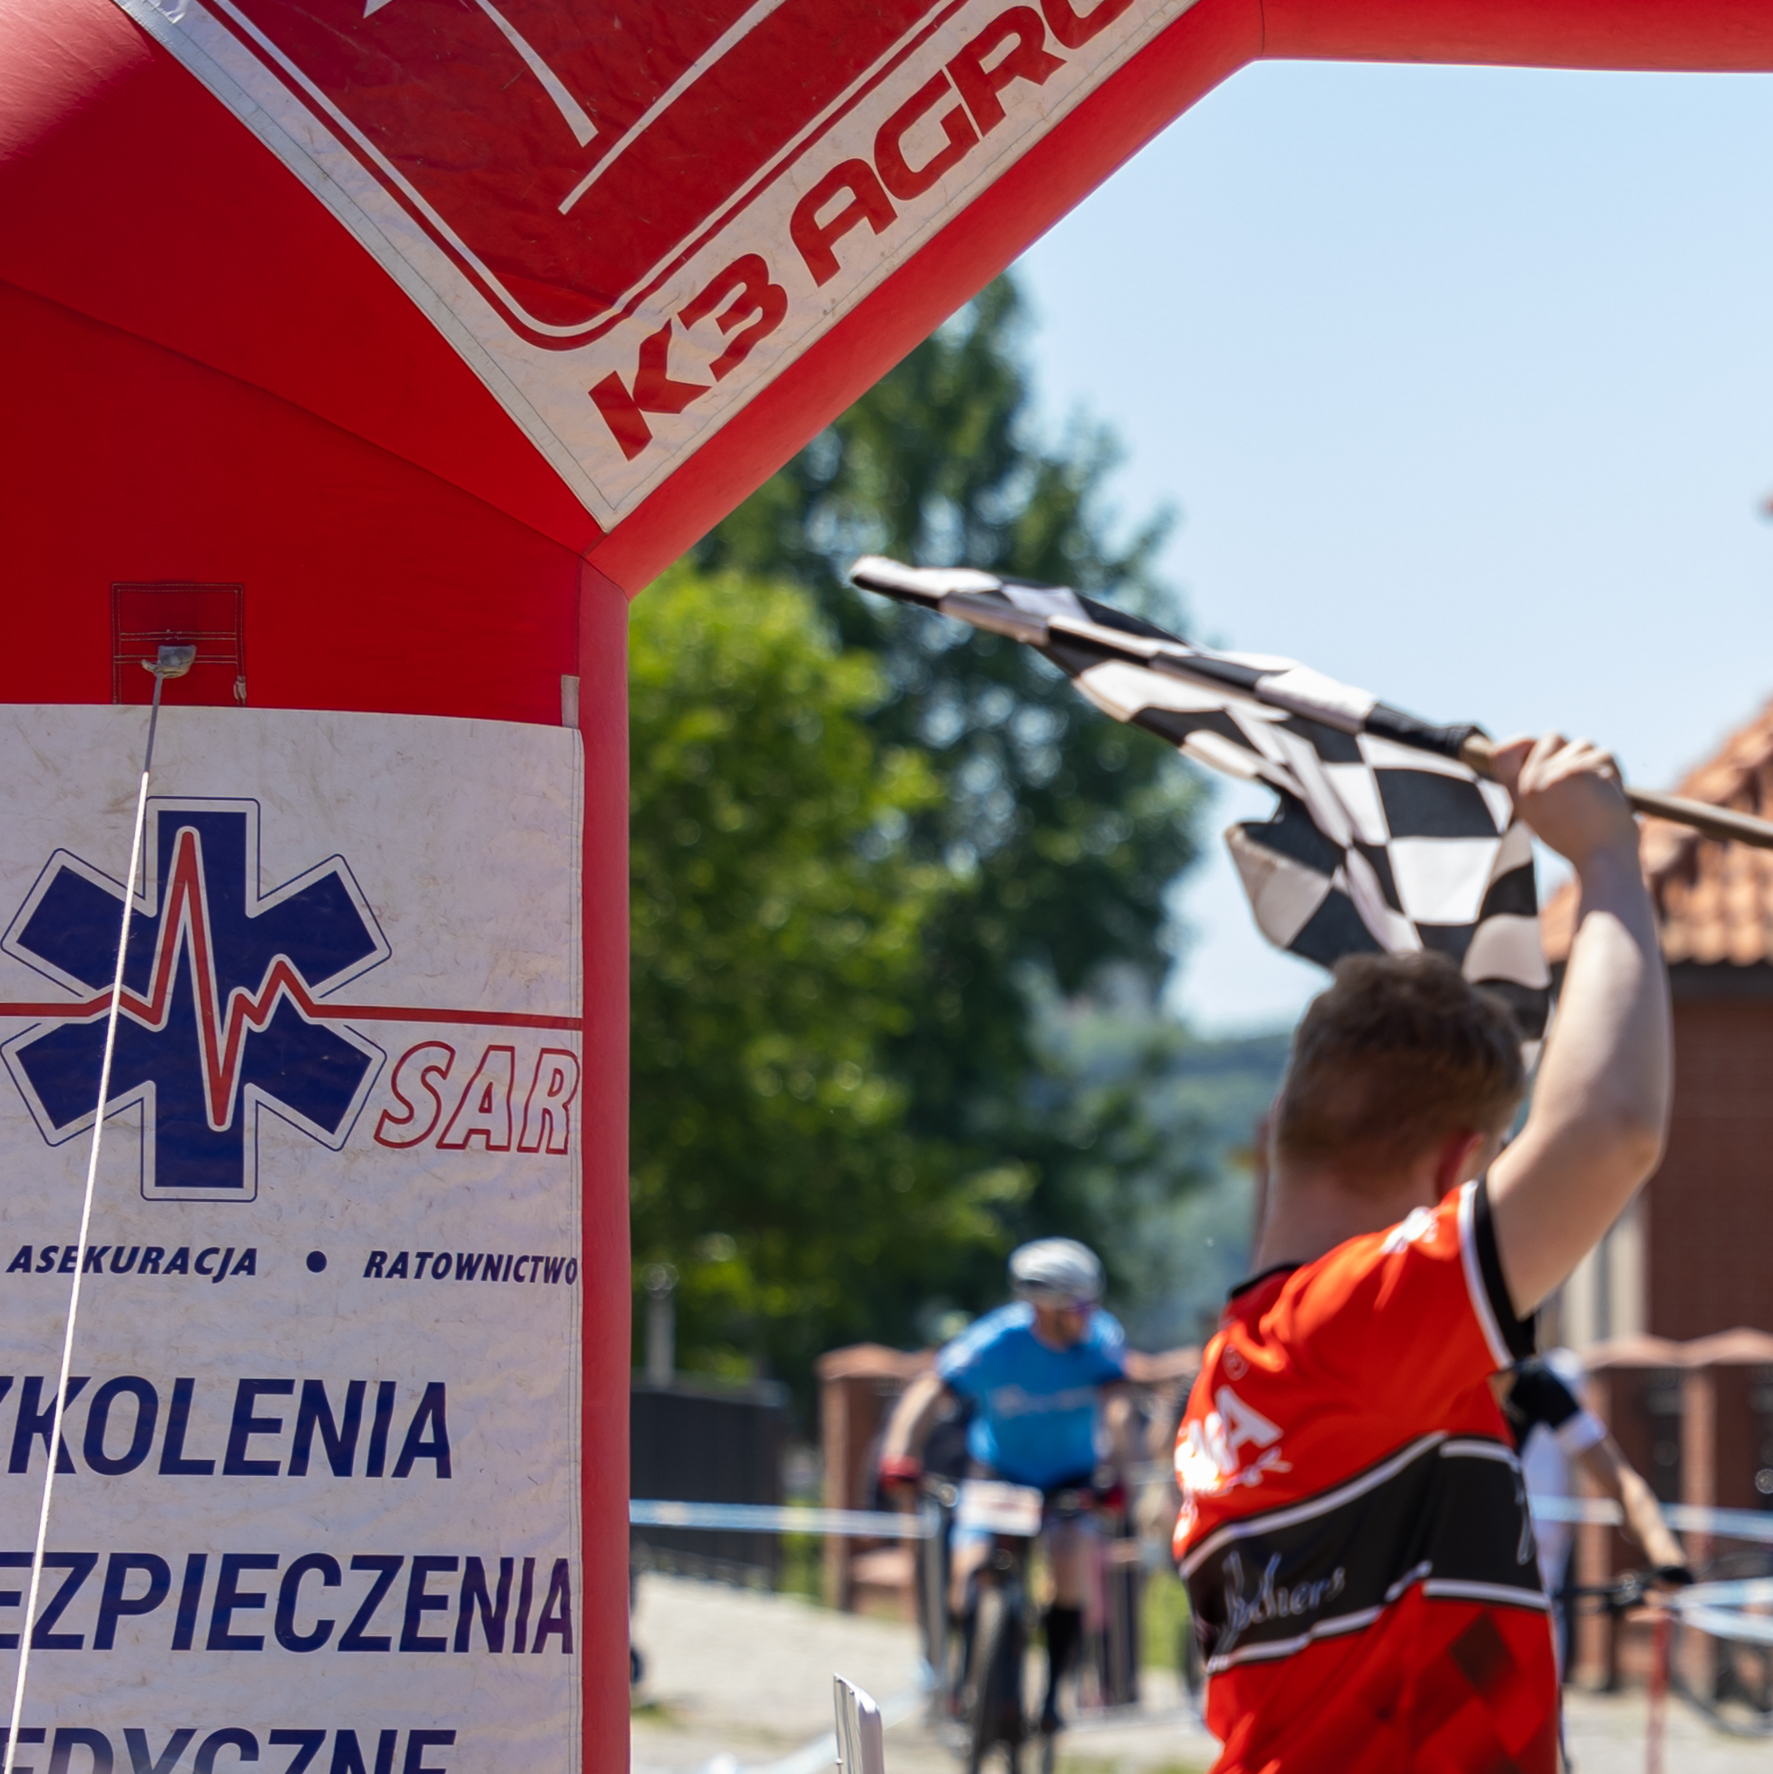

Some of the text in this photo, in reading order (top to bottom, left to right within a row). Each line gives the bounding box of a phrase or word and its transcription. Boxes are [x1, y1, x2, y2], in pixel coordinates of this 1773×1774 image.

[588, 252, 789, 461] K3
[373, 1040, 581, 1156] SAR
[5, 1244, 579, 1285] ASEKURACJA RATOWNICTWO
[0, 1375, 453, 1480] KOLENIA
